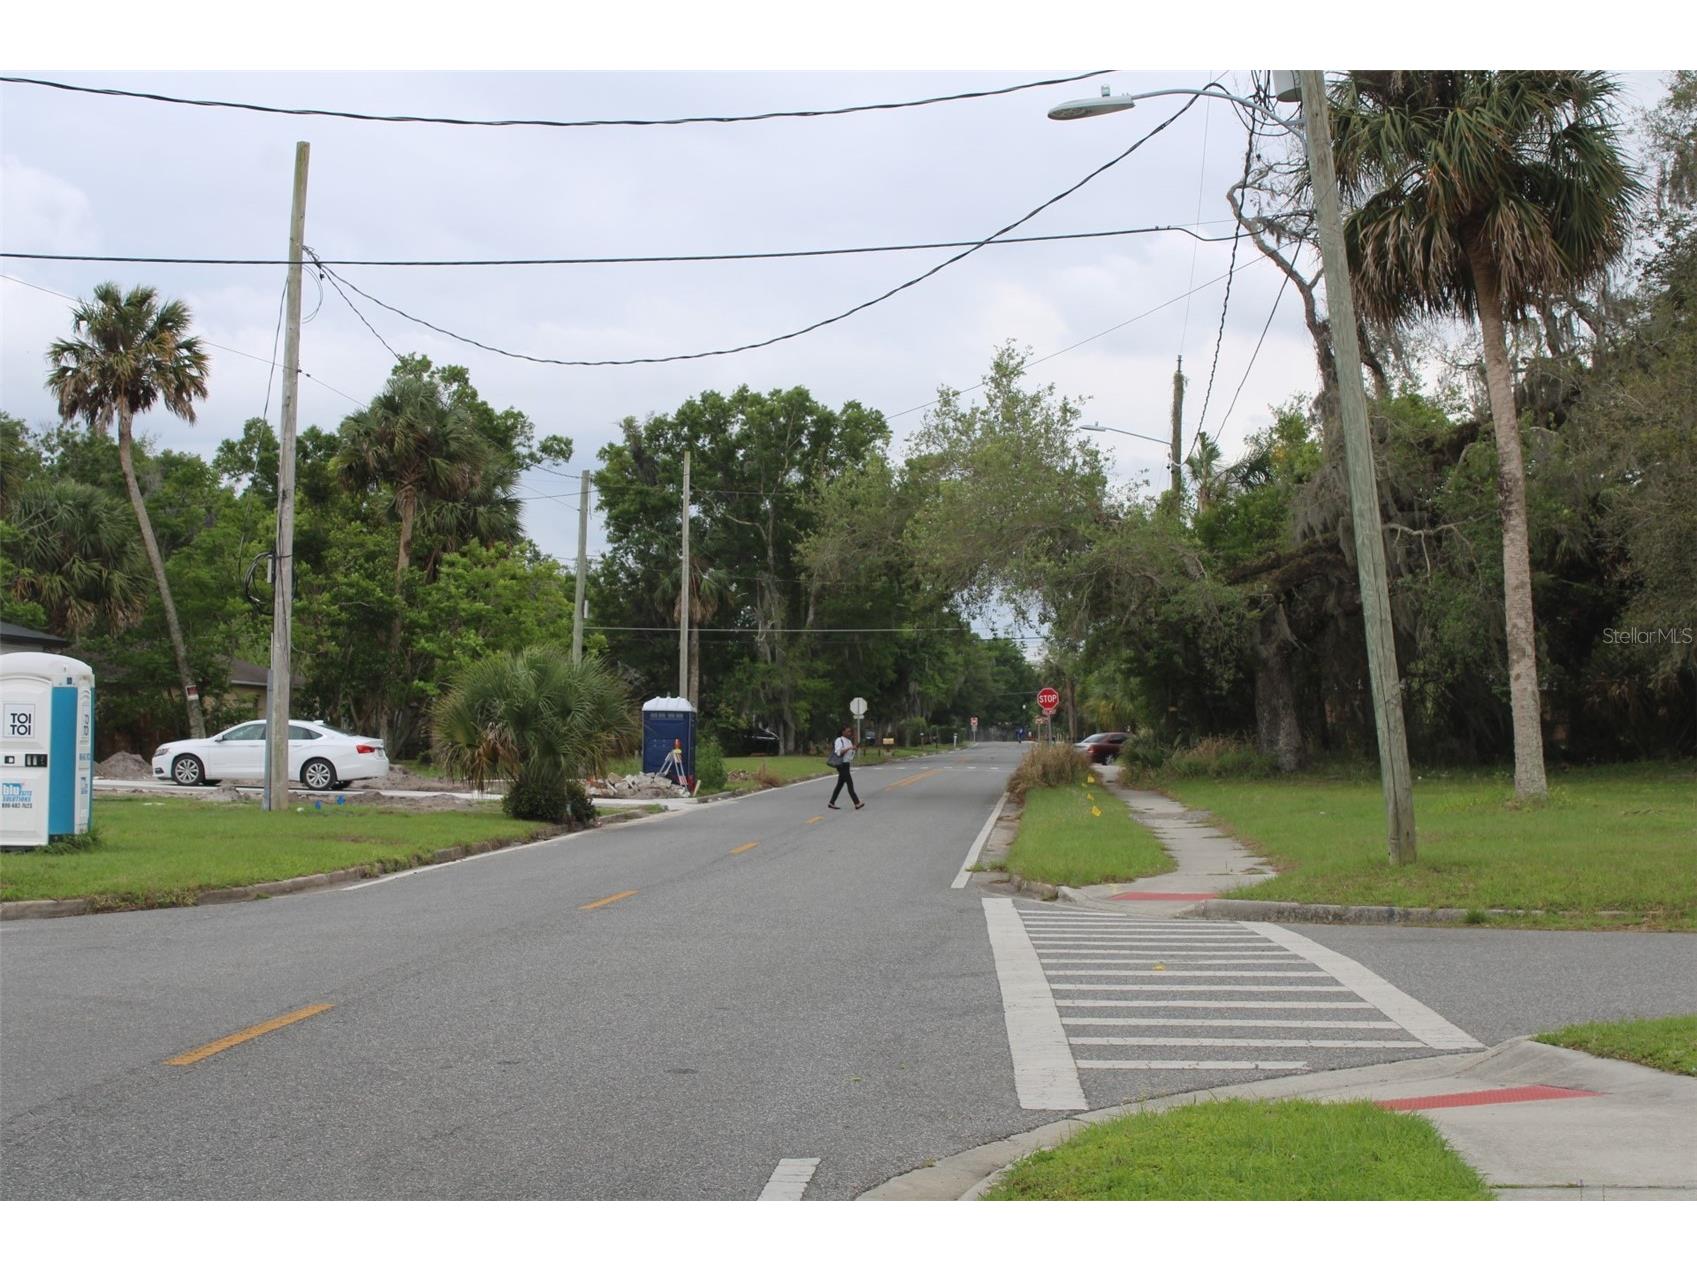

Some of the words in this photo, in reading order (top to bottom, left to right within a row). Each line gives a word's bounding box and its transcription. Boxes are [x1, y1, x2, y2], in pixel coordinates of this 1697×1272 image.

[1039, 694, 1057, 703] STOP
[10, 713, 31, 724] TOI
[10, 724, 31, 735] TOI
